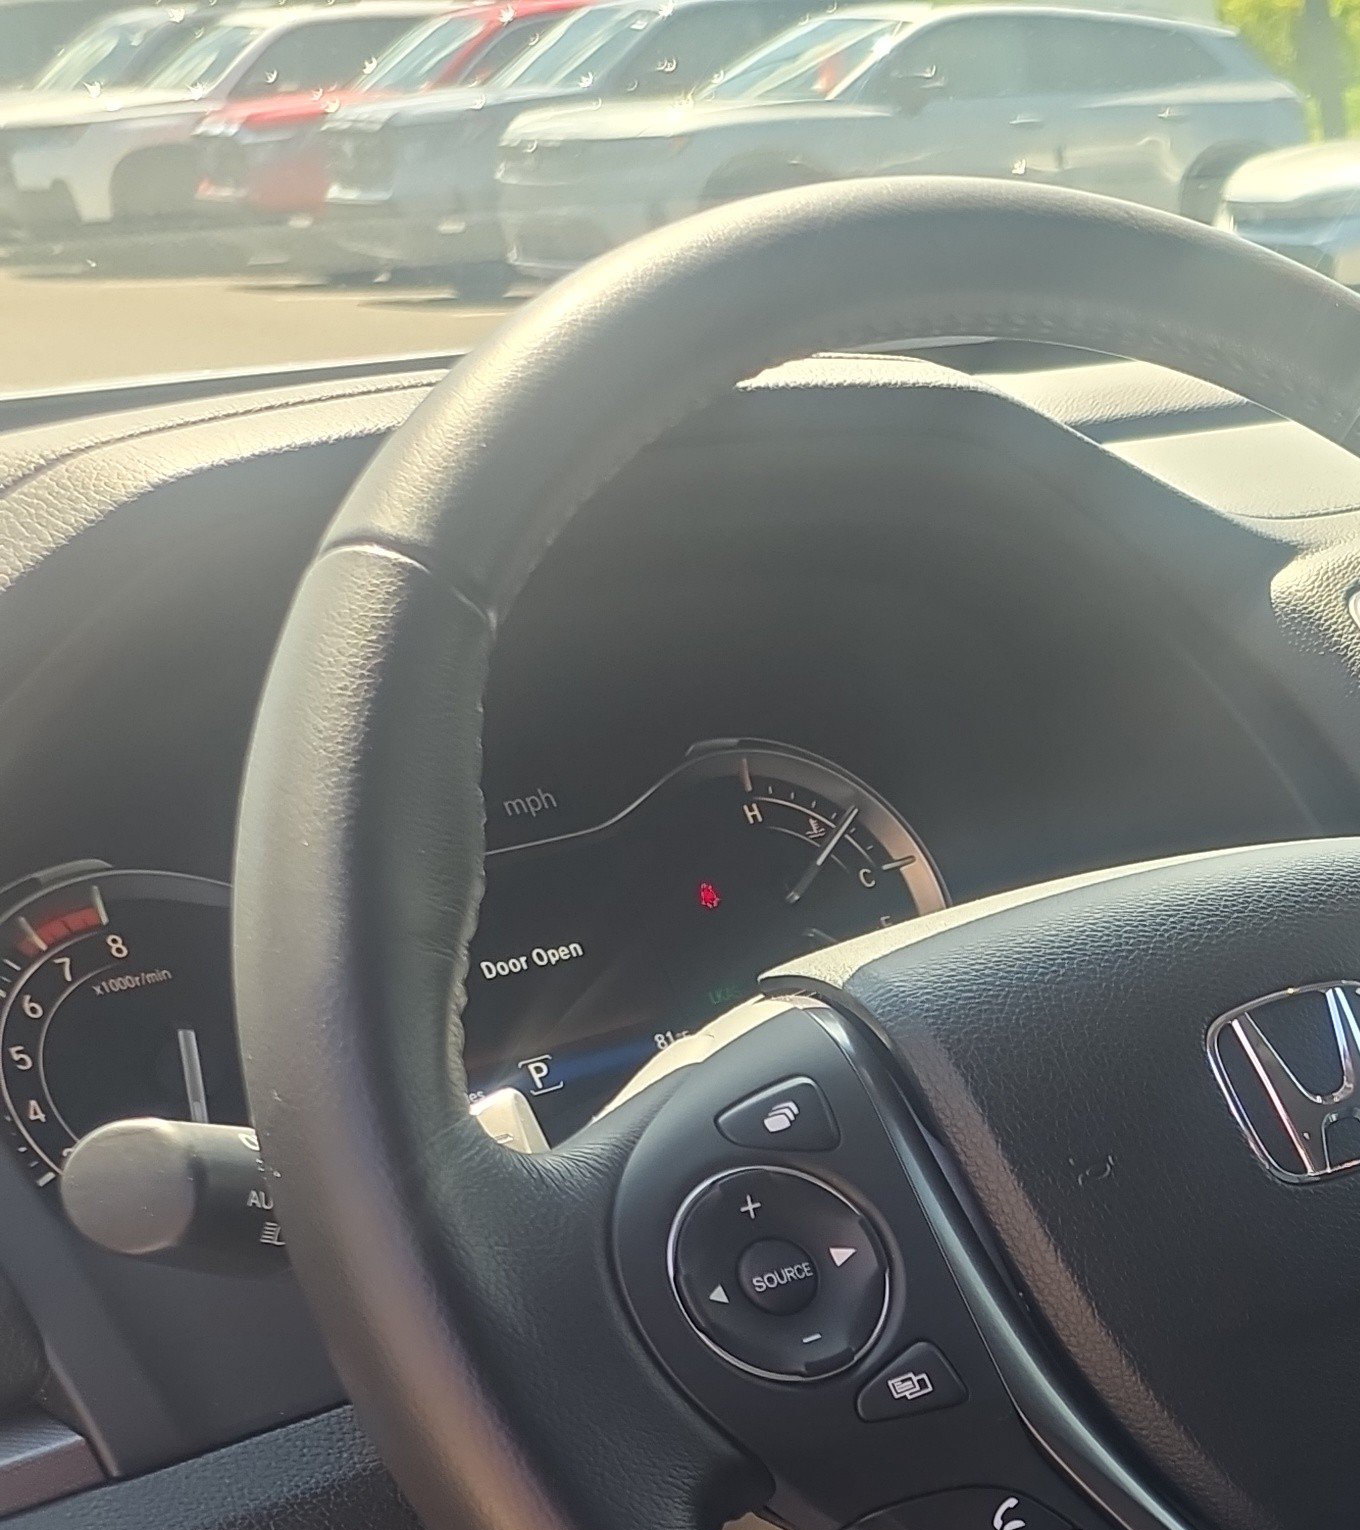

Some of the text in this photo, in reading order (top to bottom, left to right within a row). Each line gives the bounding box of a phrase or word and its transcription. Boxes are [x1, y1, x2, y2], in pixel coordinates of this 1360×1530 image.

[503, 788, 557, 817] mph
[743, 803, 763, 825] H
[858, 868, 876, 889] C
[105, 934, 129, 959] 8
[53, 957, 73, 982] 7
[480, 941, 584, 980] Door Open
[92, 968, 172, 996] x1000r/min
[23, 994, 44, 1019] 6
[9, 1045, 33, 1071] 5
[527, 1061, 549, 1090] P
[28, 1099, 47, 1123] 4
[246, 1190, 274, 1210] AU
[752, 1262, 814, 1292] SOURCE
